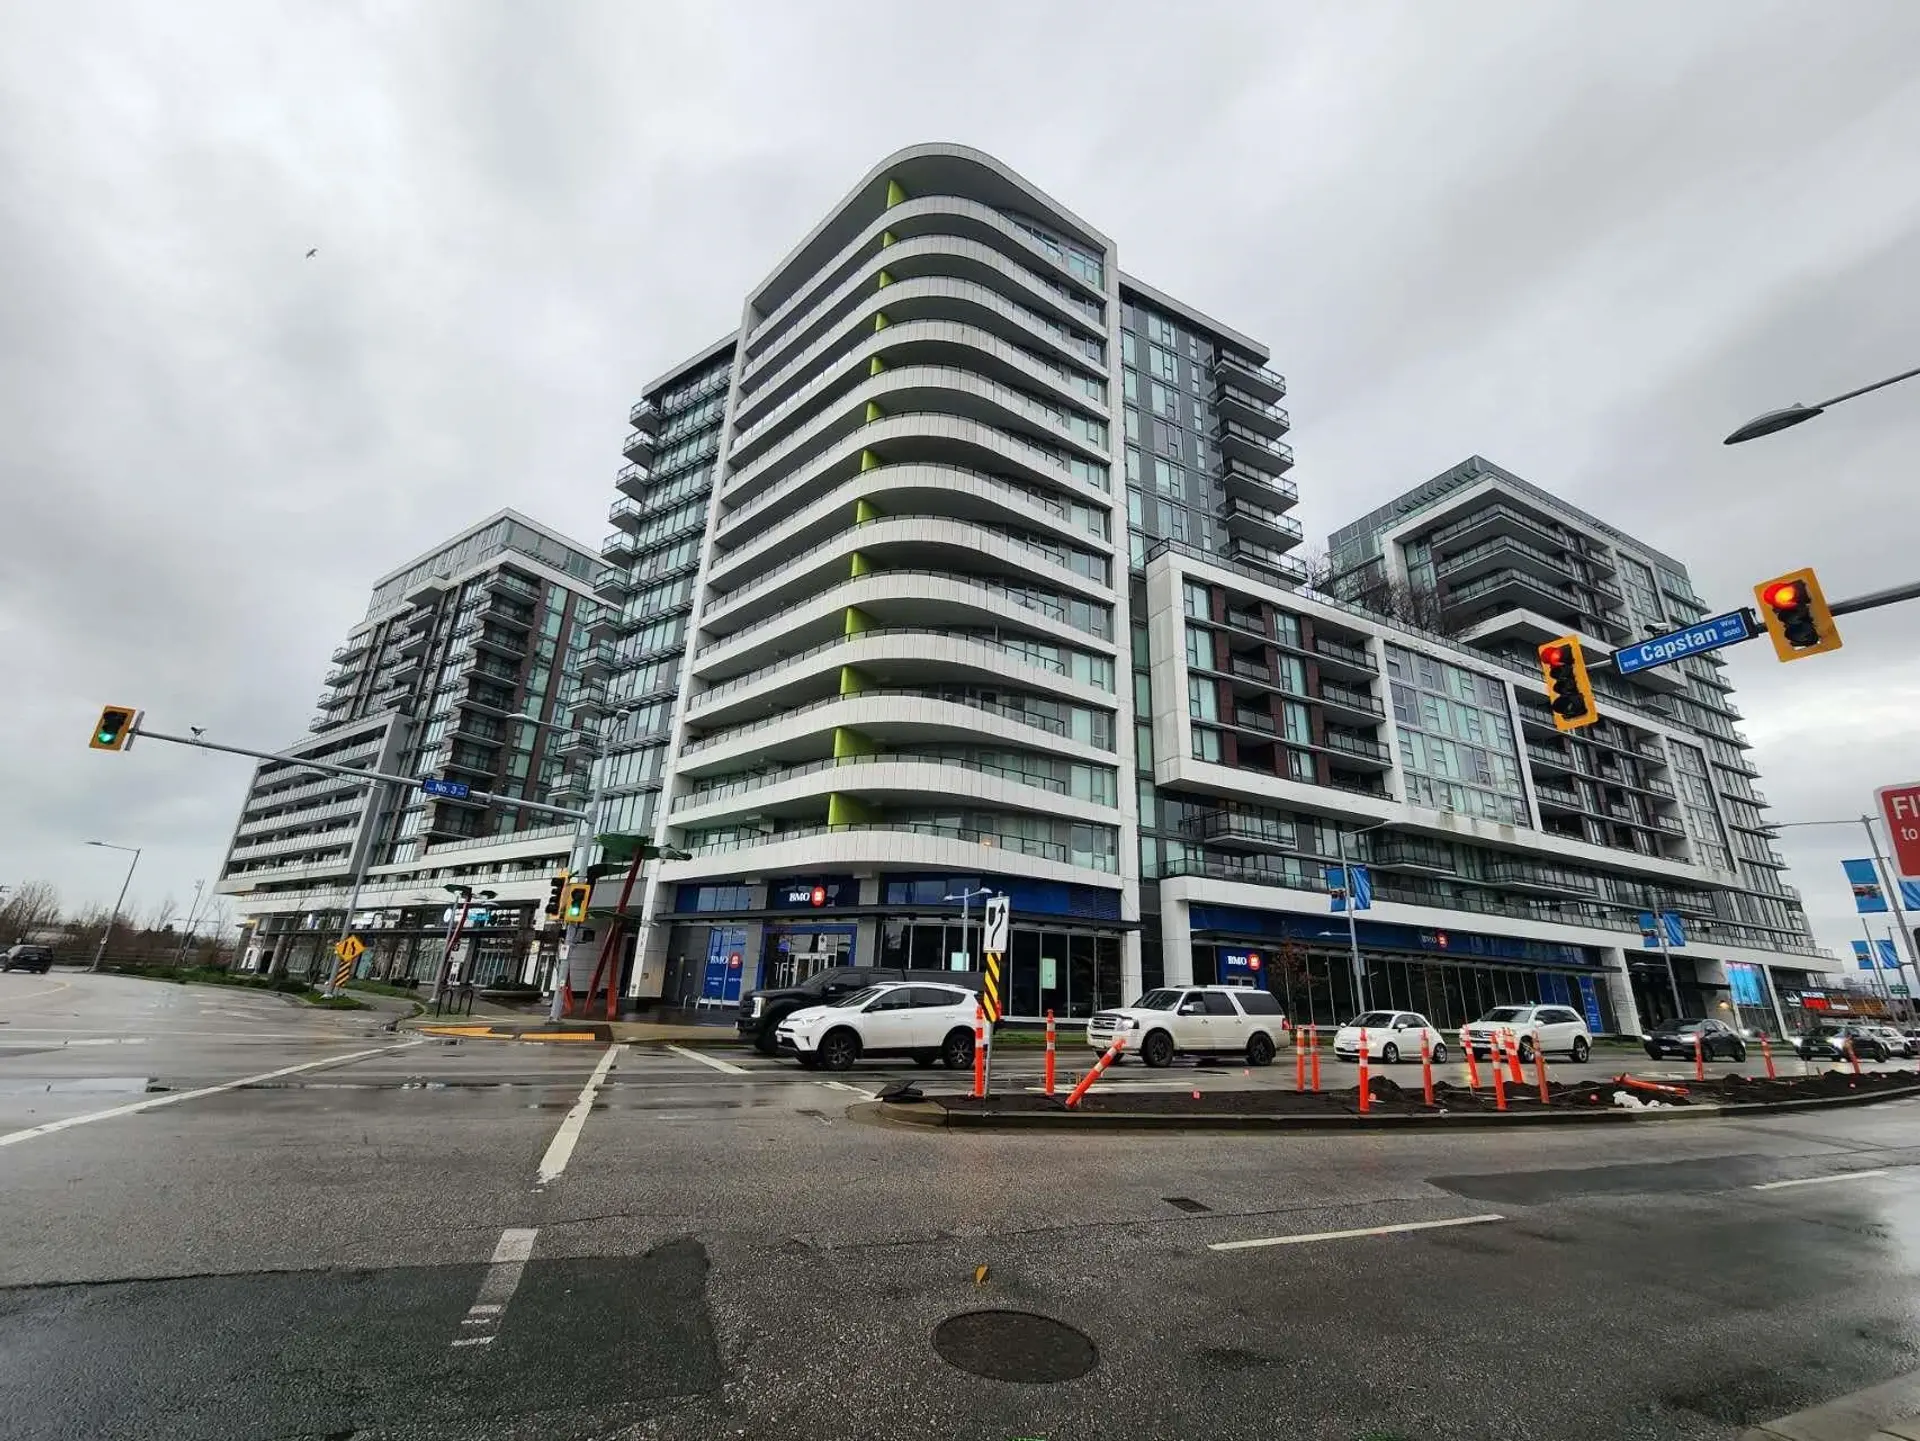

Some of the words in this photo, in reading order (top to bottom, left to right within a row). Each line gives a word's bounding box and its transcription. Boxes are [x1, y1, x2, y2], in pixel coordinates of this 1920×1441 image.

[1641, 627, 1719, 661] Capstan
[435, 783, 449, 794] No.
[450, 785, 458, 795] 3
[1891, 794, 1920, 820] FI
[1901, 826, 1918, 841] to
[789, 892, 811, 902] BMO
[1227, 955, 1248, 965] BMO
